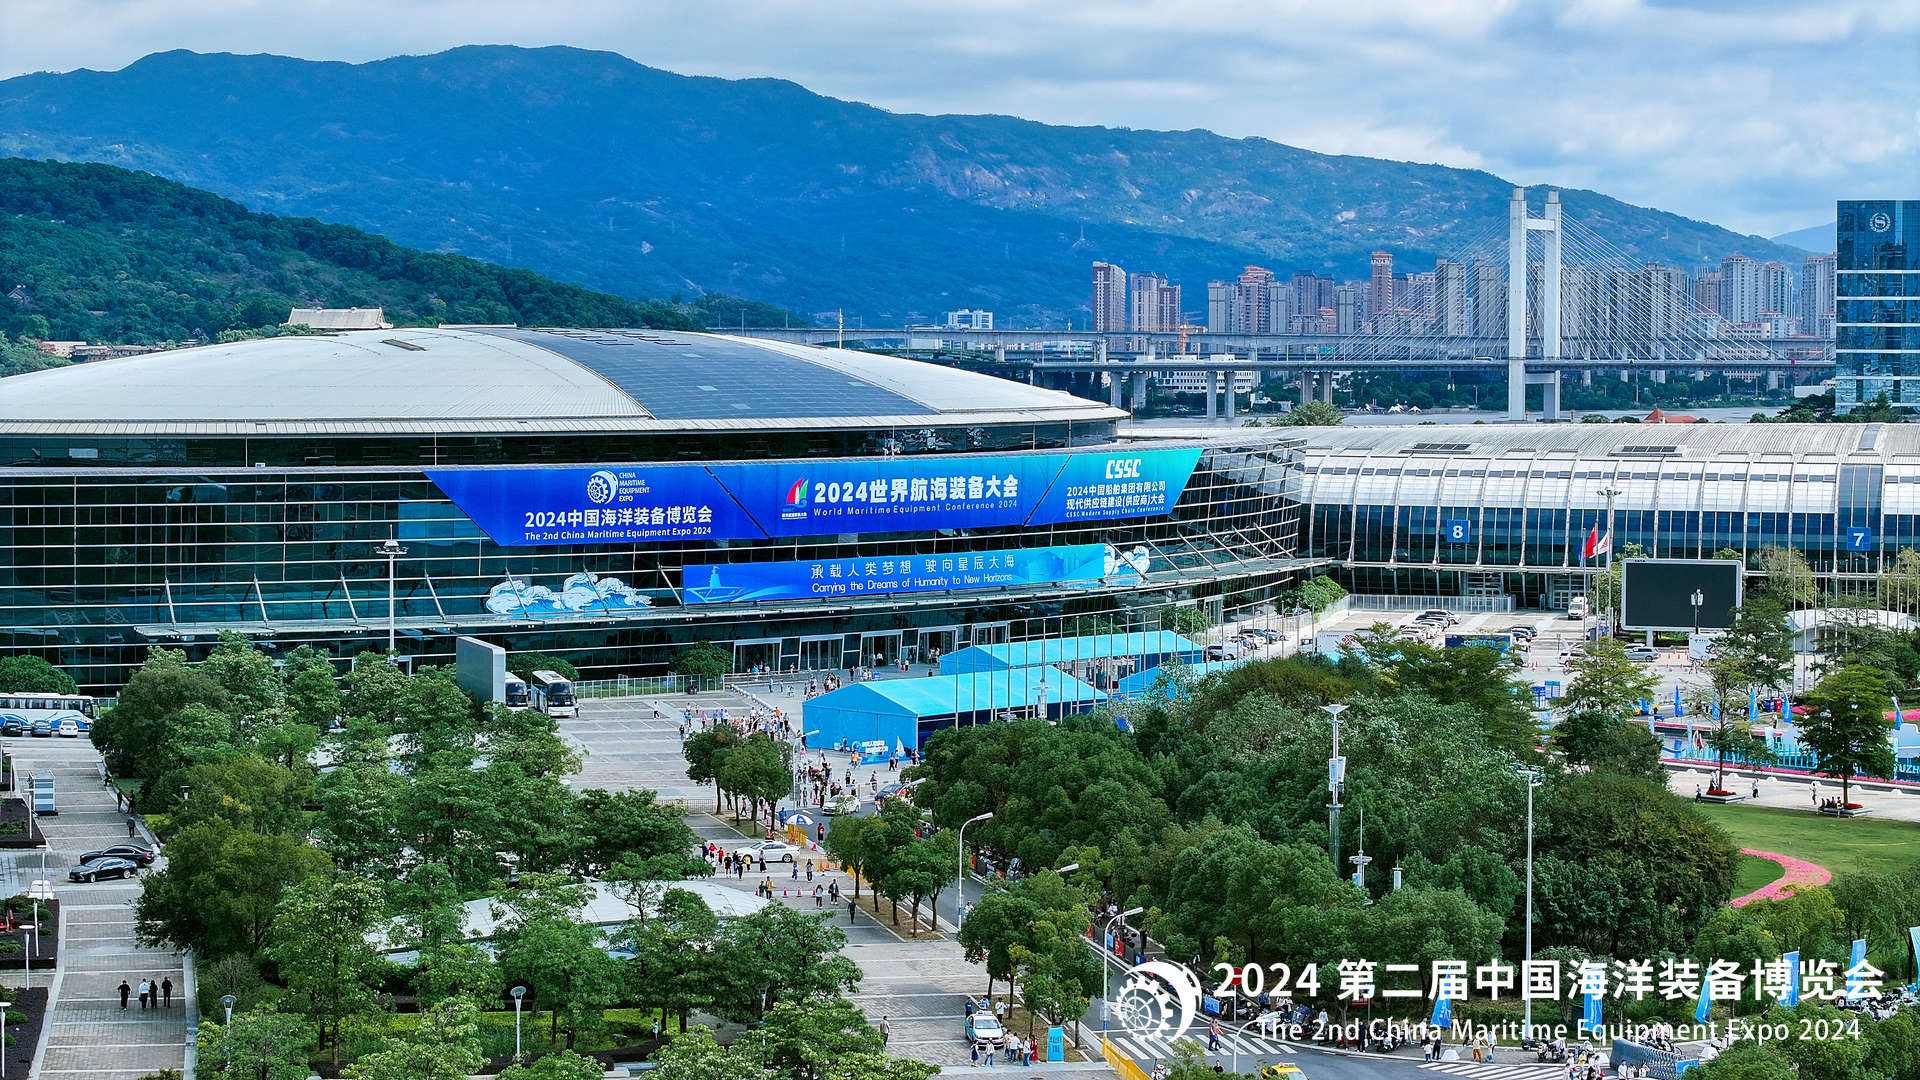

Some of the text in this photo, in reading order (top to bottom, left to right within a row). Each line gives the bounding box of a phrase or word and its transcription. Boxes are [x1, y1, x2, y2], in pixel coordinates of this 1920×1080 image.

[618, 472, 637, 480] CHINA
[1105, 458, 1142, 479] CSSC
[618, 479, 646, 487] MARITIME
[618, 487, 651, 495] EQUIPMENT
[813, 473, 1019, 504] 2024世界航海装备大会
[1066, 480, 1166, 497] 2024中国船舶集团有限公司
[813, 499, 1018, 516] World Maritime Equipment Conference 2024
[524, 505, 713, 529] 2024中国海洋装备博览会
[524, 526, 712, 541] The 2nd China Maritime Equipment Expo 2024
[1453, 525, 1463, 538] 8
[1853, 532, 1864, 546] 7
[811, 554, 1015, 580] 承载人类梦想 驶向星辰大海
[812, 572, 1013, 594] Carrying the Dreams of Humanity to New Horizons
